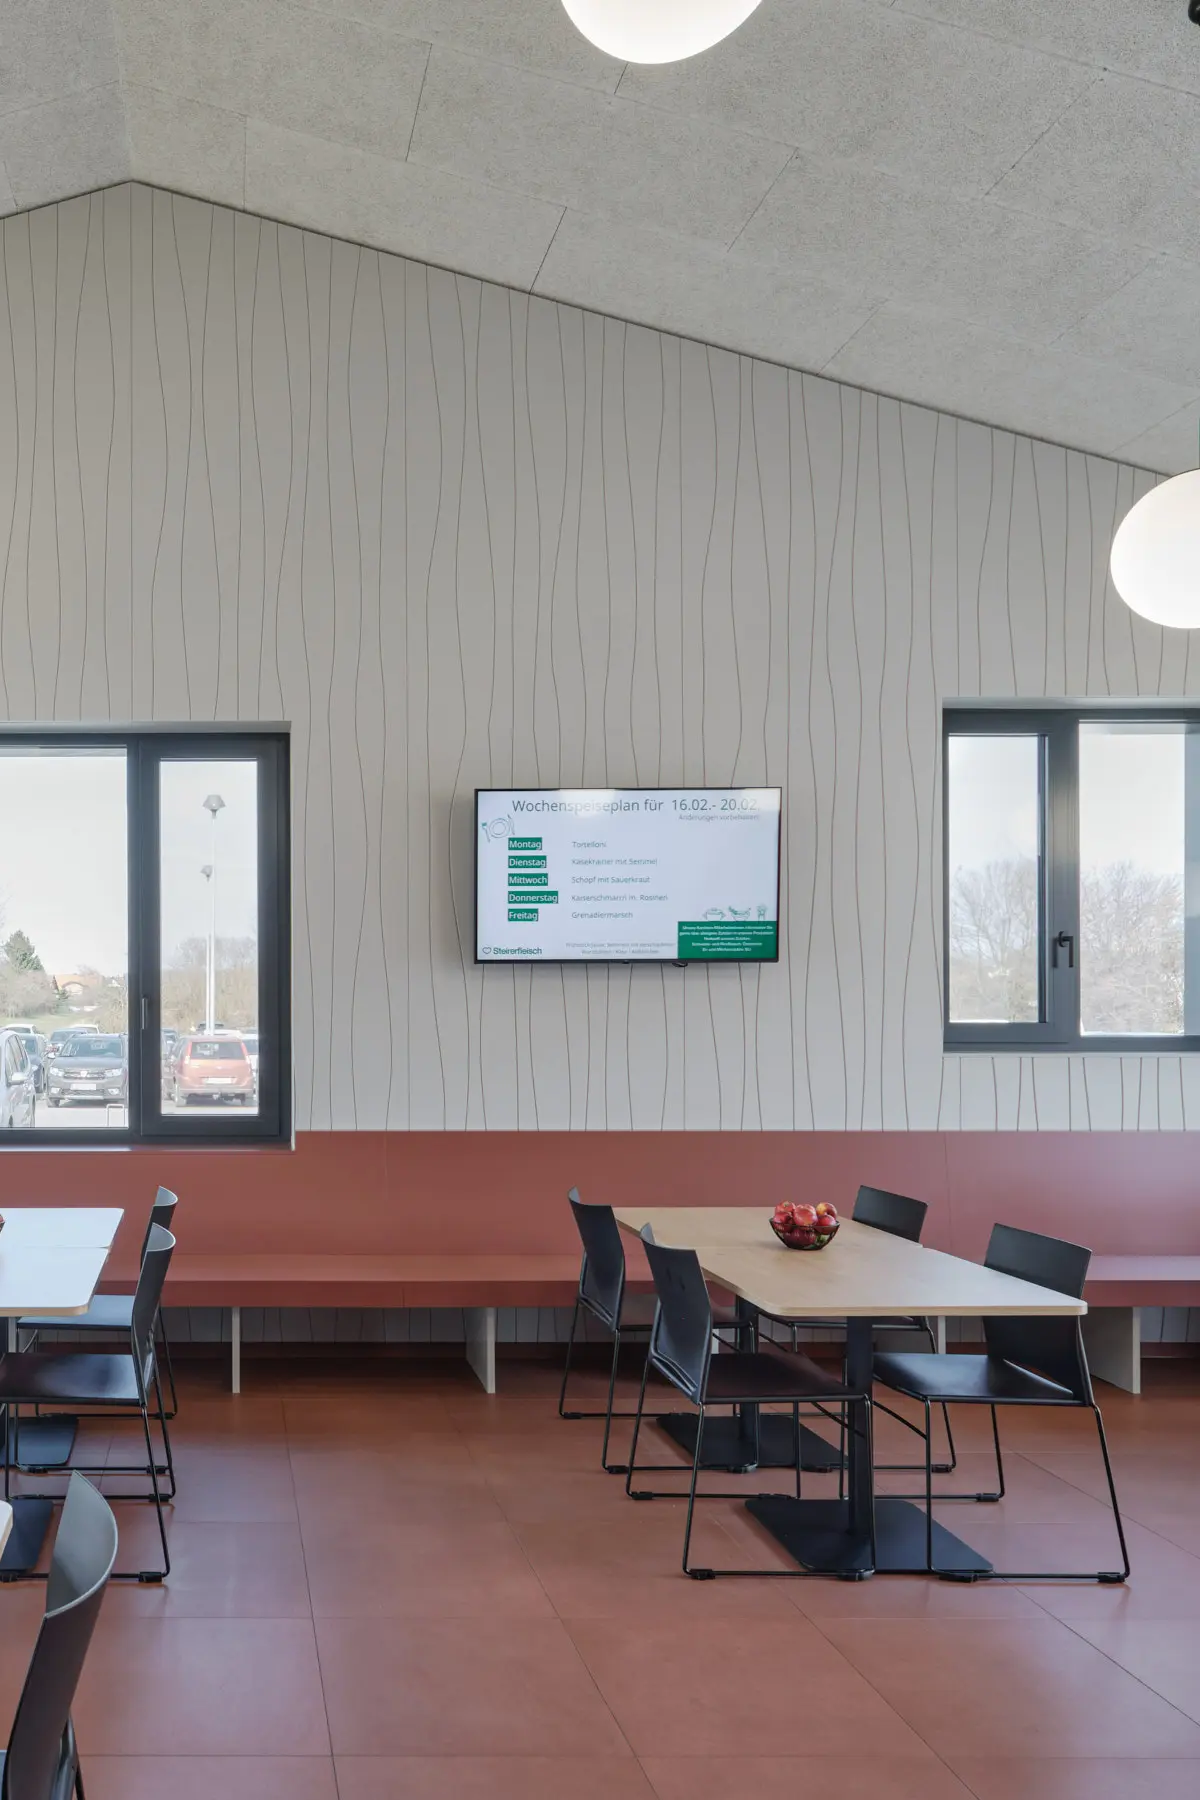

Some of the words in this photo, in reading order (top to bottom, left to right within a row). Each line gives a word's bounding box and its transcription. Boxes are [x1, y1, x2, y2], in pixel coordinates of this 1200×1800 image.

[512, 799, 640, 815] Wochenspeiseplan
[644, 799, 664, 812] für
[509, 840, 542, 850] Montag
[509, 858, 546, 868] Dienstag
[509, 876, 548, 884] Mittwoch
[509, 894, 558, 904] Donnerstag
[509, 911, 538, 921] Freitag
[493, 947, 542, 955] Steirerfleisch
